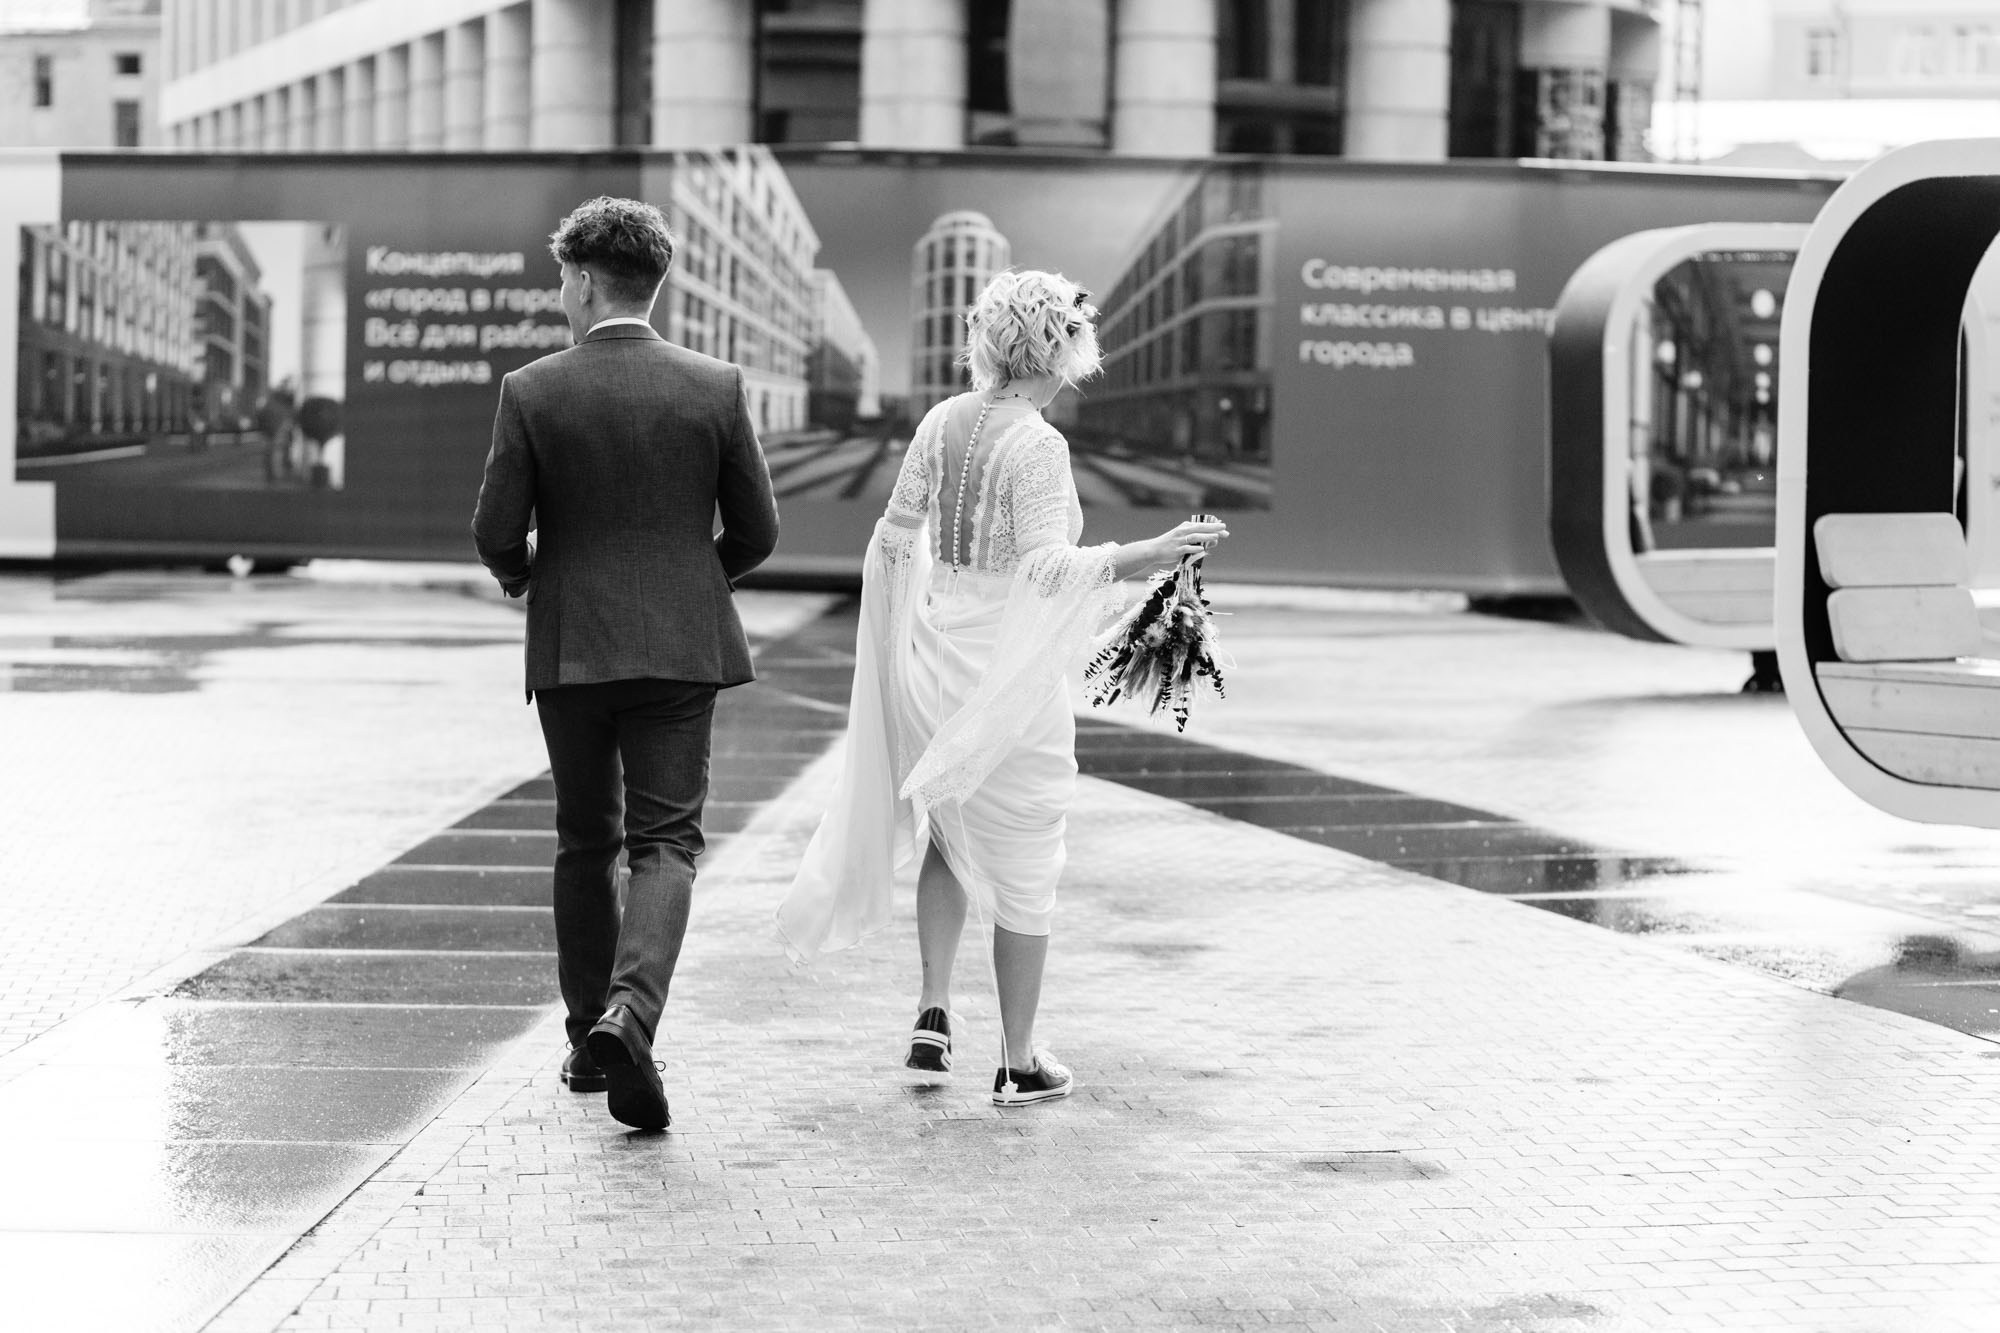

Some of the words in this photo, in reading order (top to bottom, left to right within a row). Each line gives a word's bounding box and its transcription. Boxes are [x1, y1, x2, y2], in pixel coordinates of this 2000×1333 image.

[366, 246, 525, 278] Концепция
[1302, 259, 1516, 294] Современная
[470, 288, 491, 312] в
[494, 288, 567, 317] горо
[1301, 303, 1445, 329] классика
[1450, 306, 1471, 330] в
[1476, 306, 1558, 337] центр
[421, 324, 477, 349] для
[1300, 340, 1415, 370] города
[364, 360, 385, 383] и
[387, 359, 492, 387] отдыха
